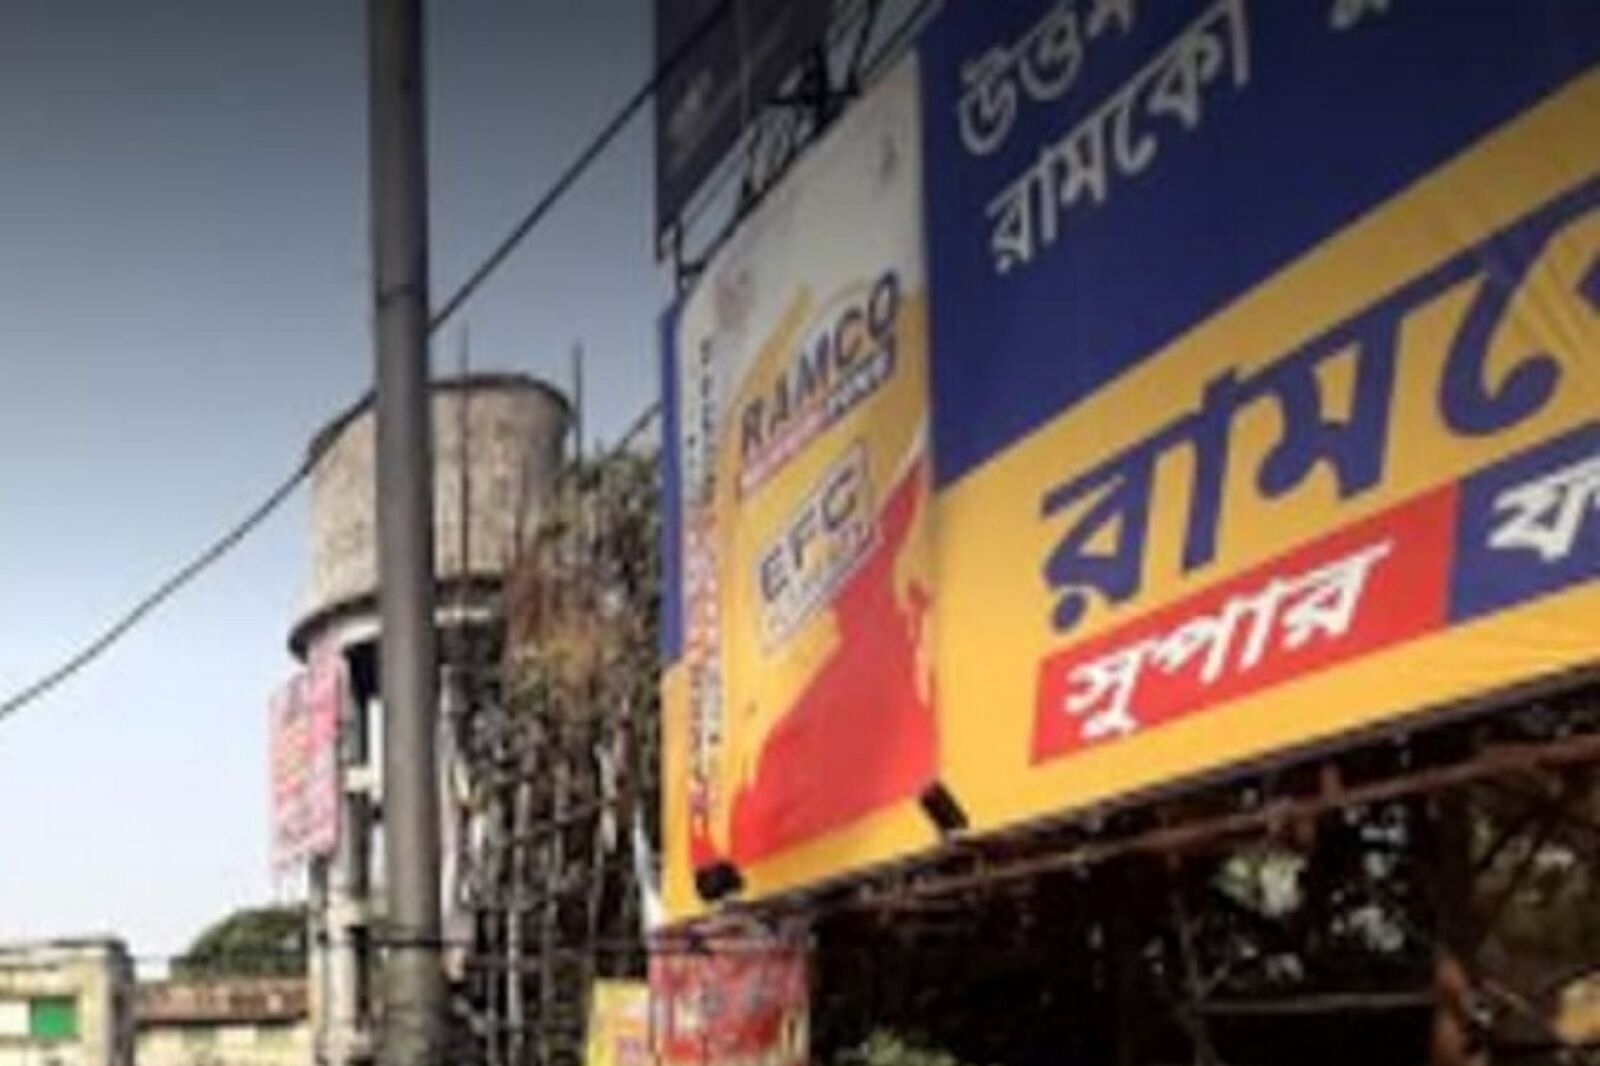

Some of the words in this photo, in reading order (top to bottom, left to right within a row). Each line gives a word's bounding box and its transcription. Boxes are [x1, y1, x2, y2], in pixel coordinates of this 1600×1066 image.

[987, 0, 1249, 272] রামকো
[741, 270, 898, 456] RAMCO
[760, 464, 860, 602] EFC
[1064, 538, 1395, 740] সুপার
